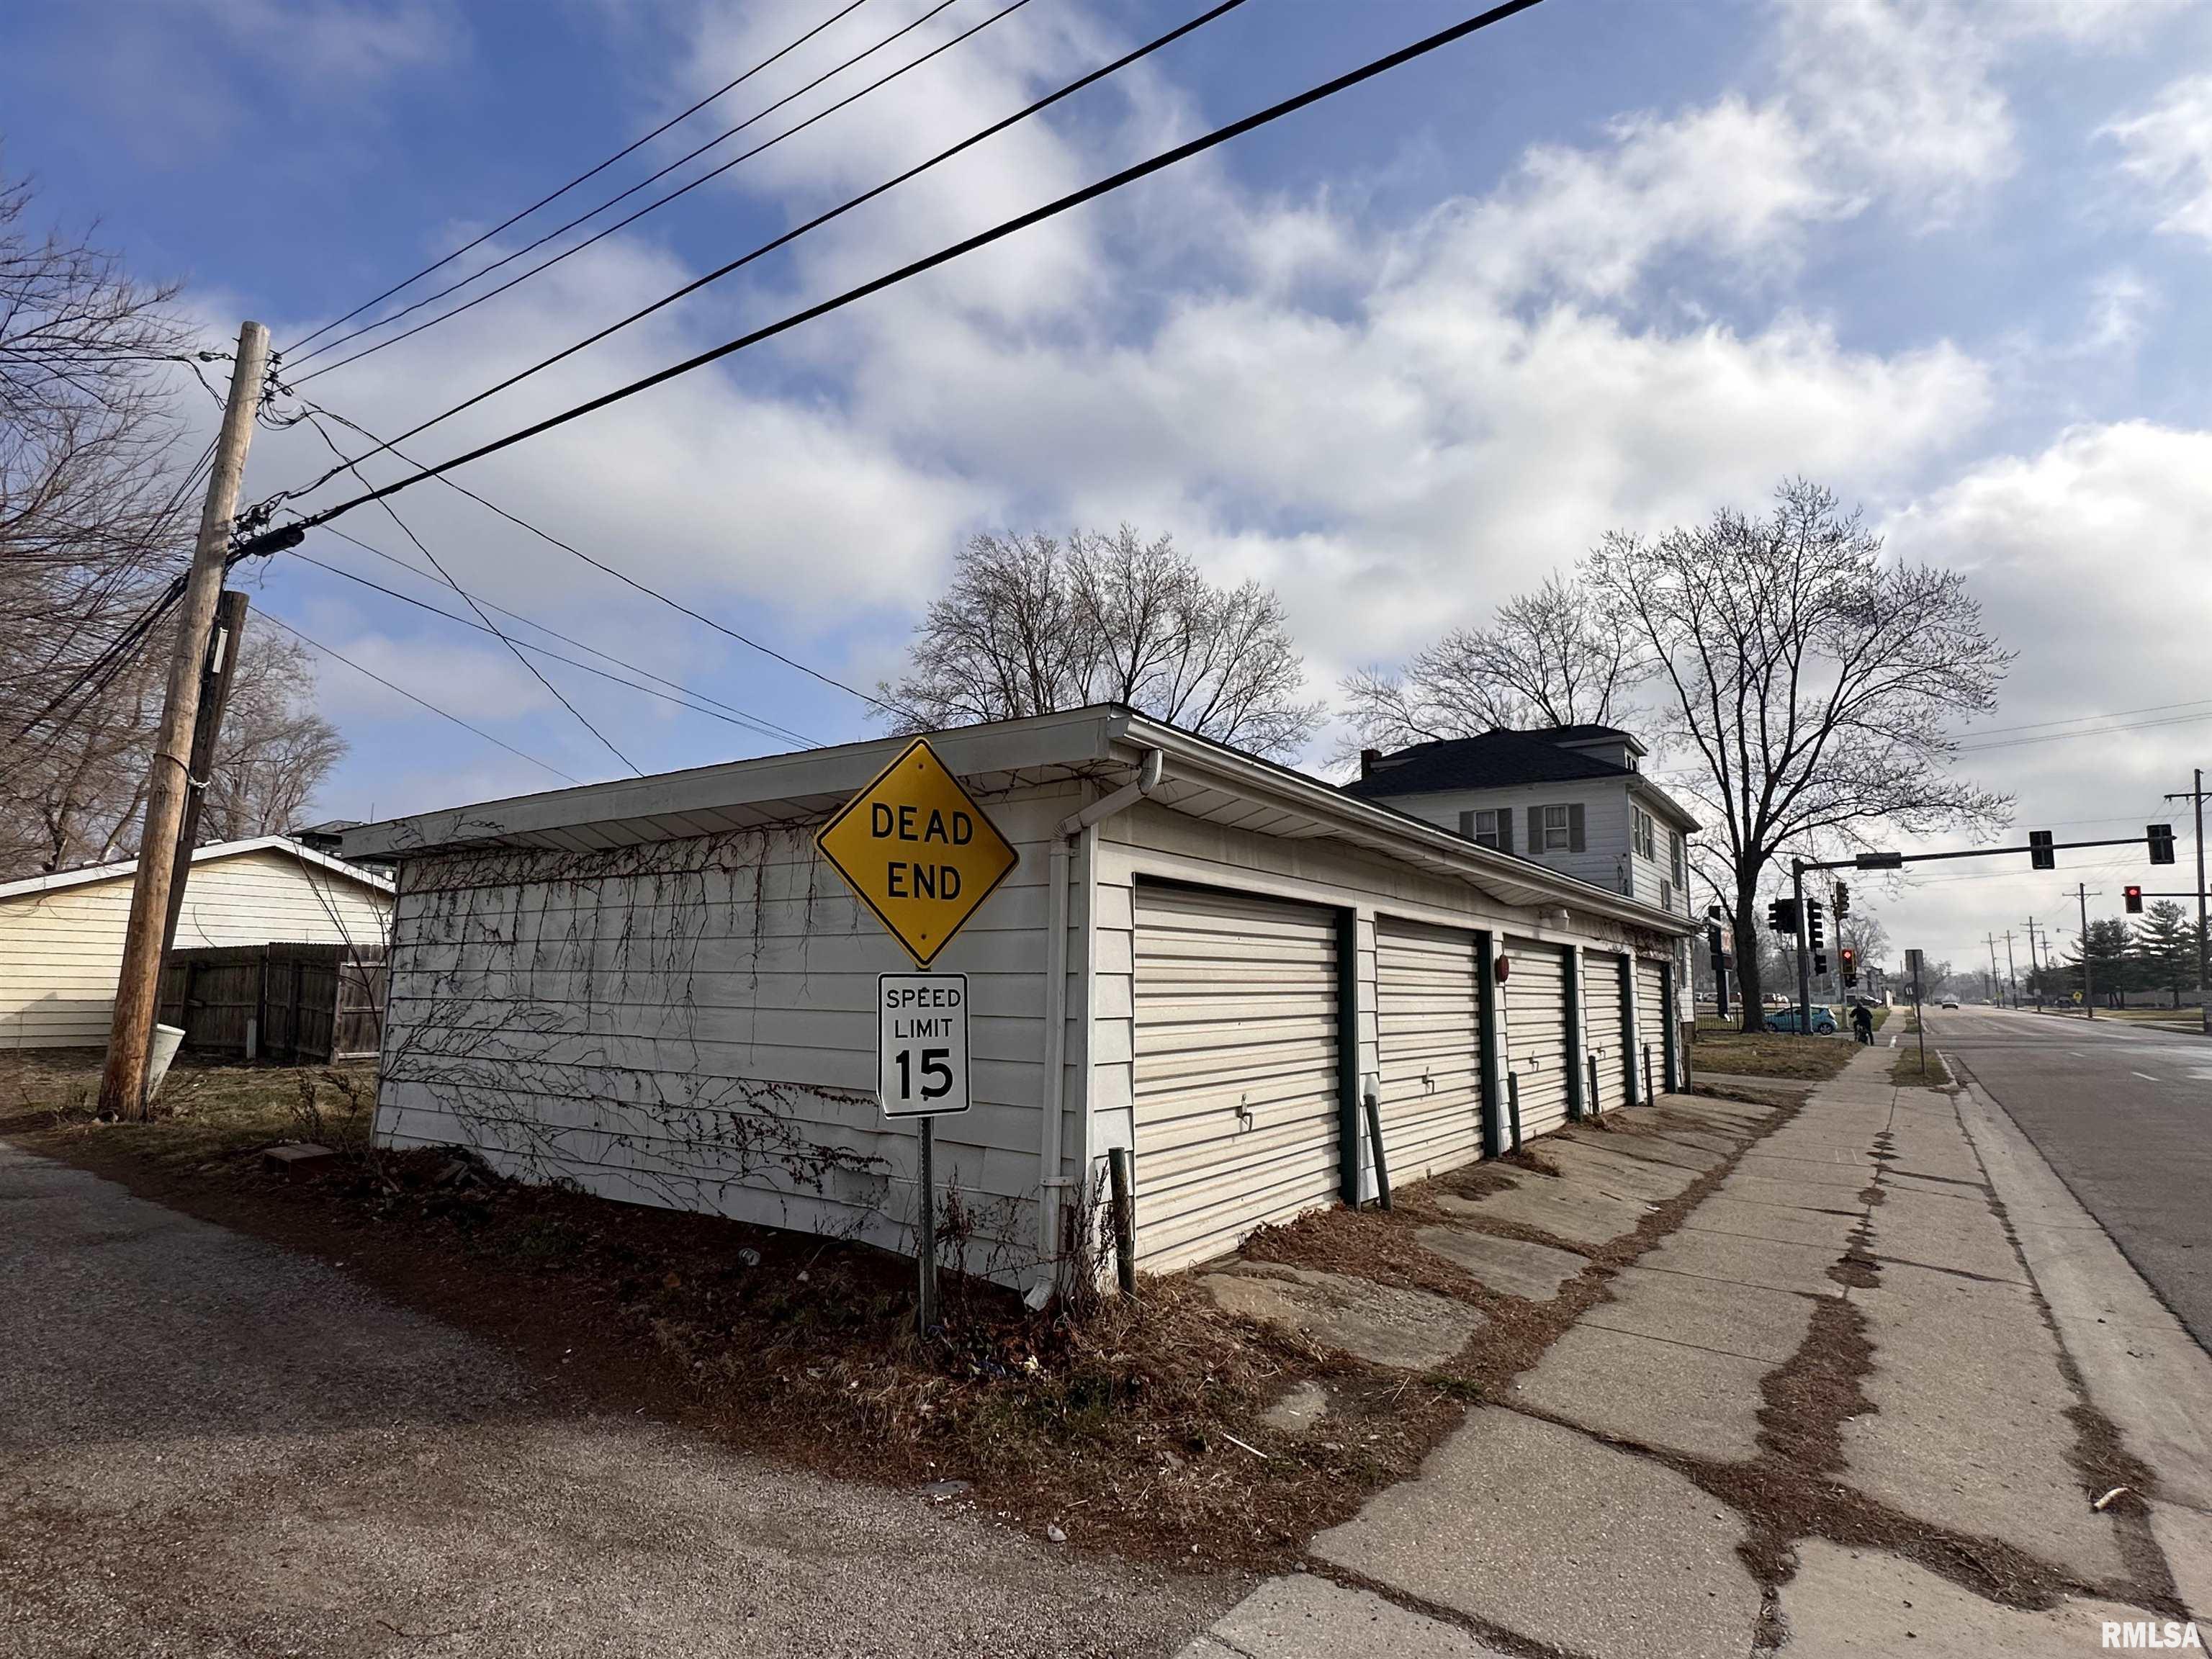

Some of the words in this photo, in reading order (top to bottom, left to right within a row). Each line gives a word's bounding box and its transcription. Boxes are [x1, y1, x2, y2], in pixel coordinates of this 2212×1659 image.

[872, 802, 974, 845] DEAD
[888, 861, 961, 900] END
[886, 989, 961, 1008] SPEED
[895, 1018, 953, 1038] LIMIT
[896, 1048, 953, 1099] 15
